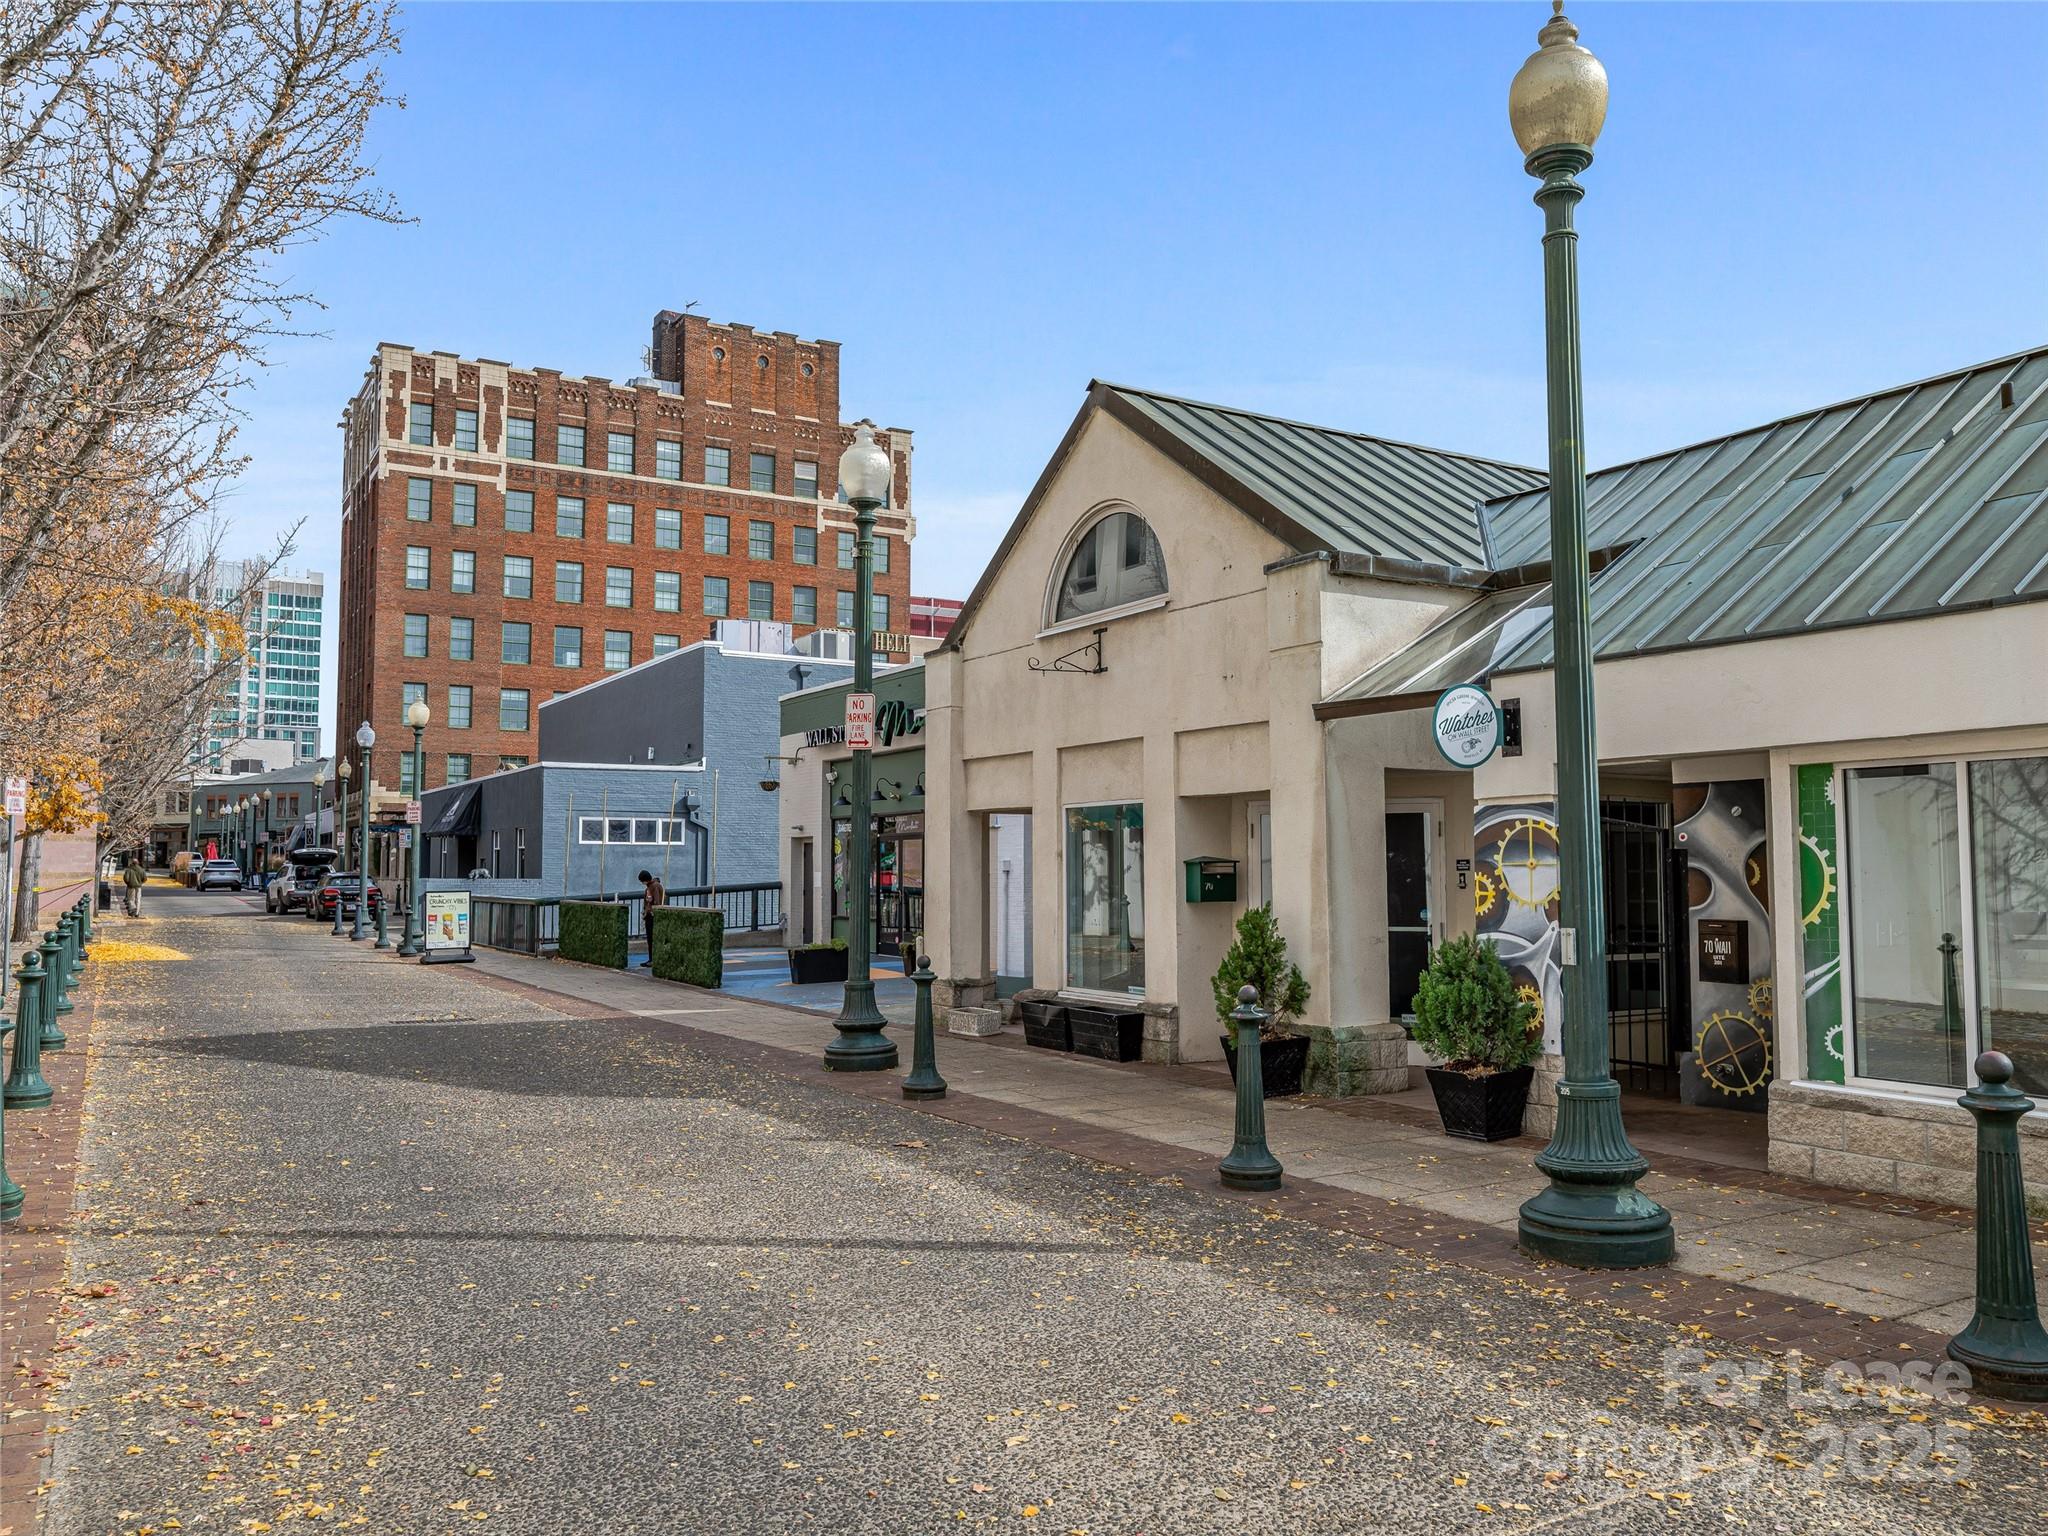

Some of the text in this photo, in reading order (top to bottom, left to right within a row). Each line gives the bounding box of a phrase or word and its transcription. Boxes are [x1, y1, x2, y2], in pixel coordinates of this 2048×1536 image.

[852, 700, 865, 710] NO
[851, 724, 864, 732] FIRE
[1438, 709, 1495, 736] Watches
[804, 728, 832, 747] WALL
[1447, 725, 1490, 741] ON WALL STREET
[1703, 939, 1714, 953] 70
